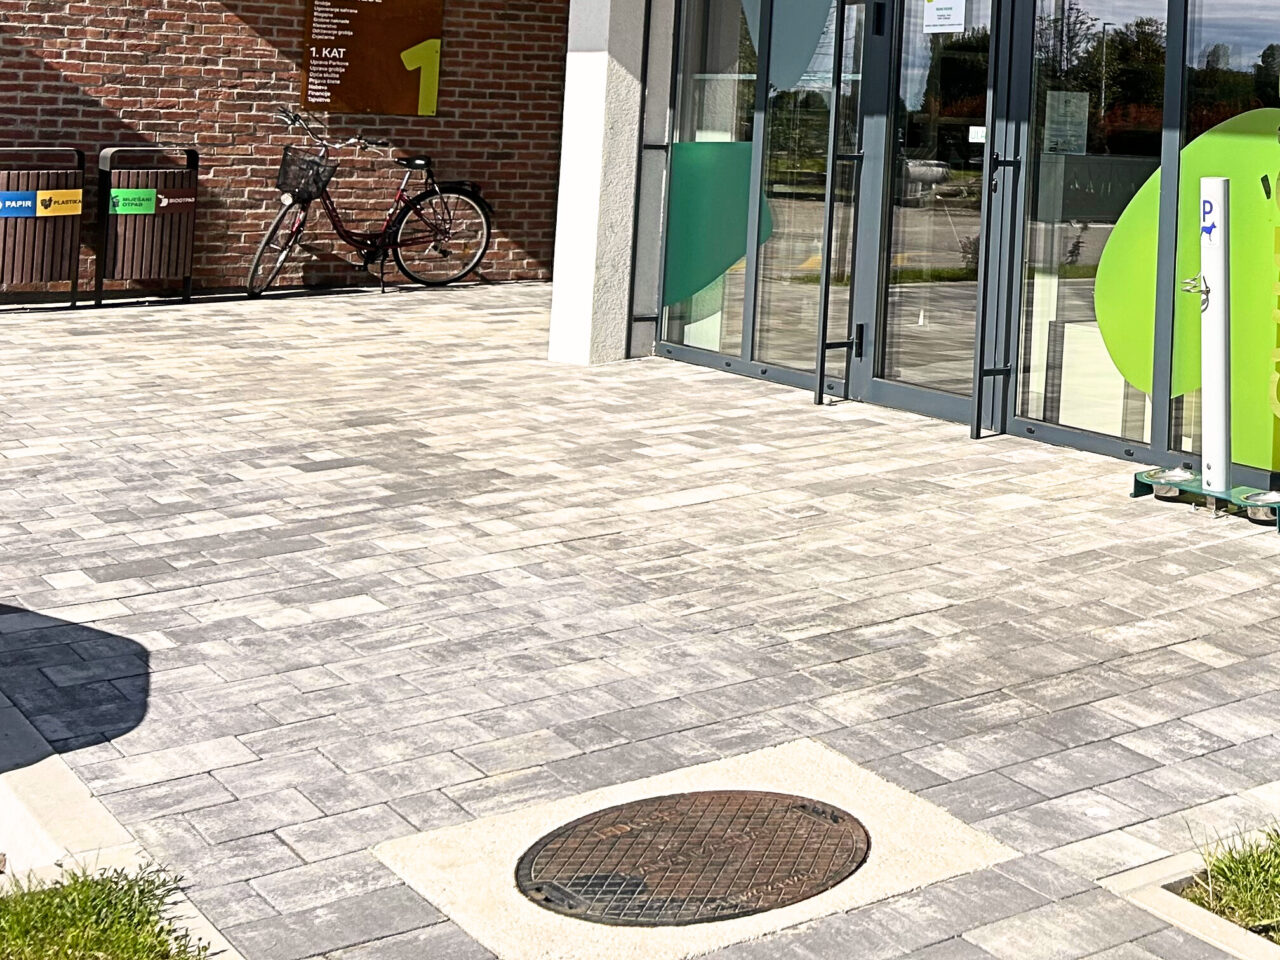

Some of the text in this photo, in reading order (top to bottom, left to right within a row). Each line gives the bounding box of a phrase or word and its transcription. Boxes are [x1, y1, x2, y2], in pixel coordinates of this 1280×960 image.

[309, 47, 346, 58] 1. KAT
[400, 38, 441, 116] 1
[5, 200, 32, 208] PAPIR
[1203, 200, 1213, 222] P
